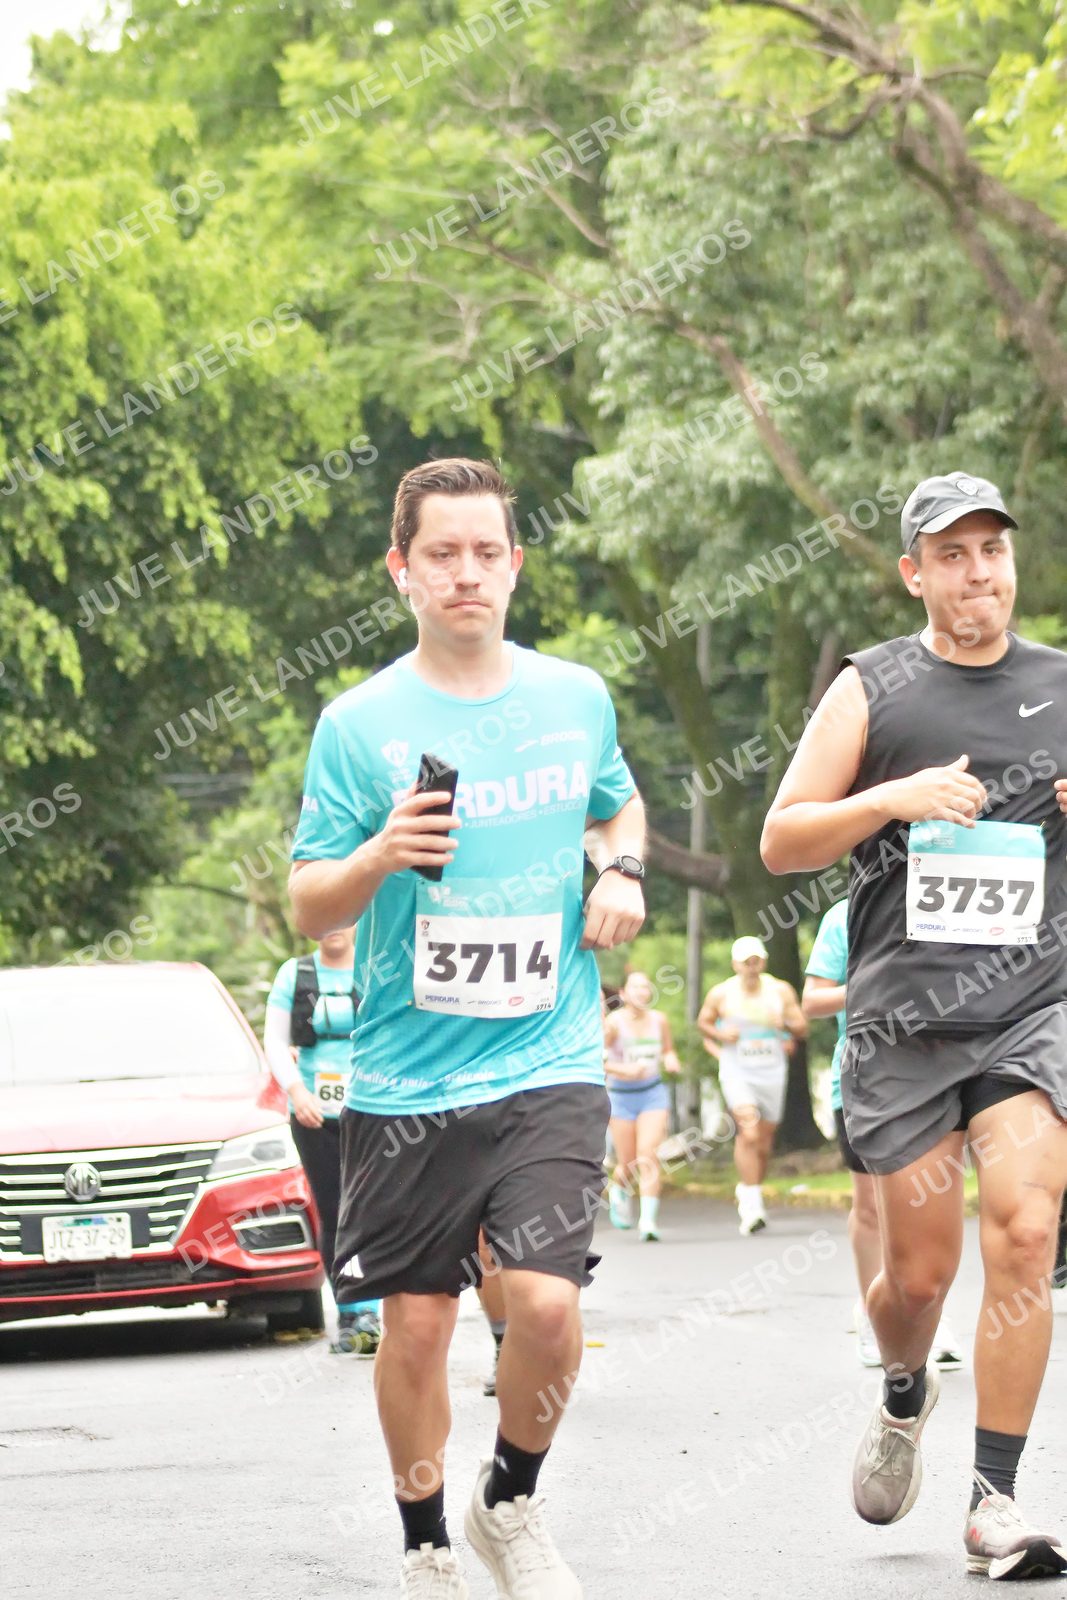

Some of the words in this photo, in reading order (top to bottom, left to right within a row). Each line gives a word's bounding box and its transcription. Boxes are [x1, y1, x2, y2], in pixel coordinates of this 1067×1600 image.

[916, 875, 1035, 916] 3737
[915, 923, 946, 932] PERDURA
[425, 940, 552, 983] 3714
[424, 994, 460, 1004] PERDURA
[535, 1002, 552, 1012] 3714
[318, 1084, 345, 1102] 68
